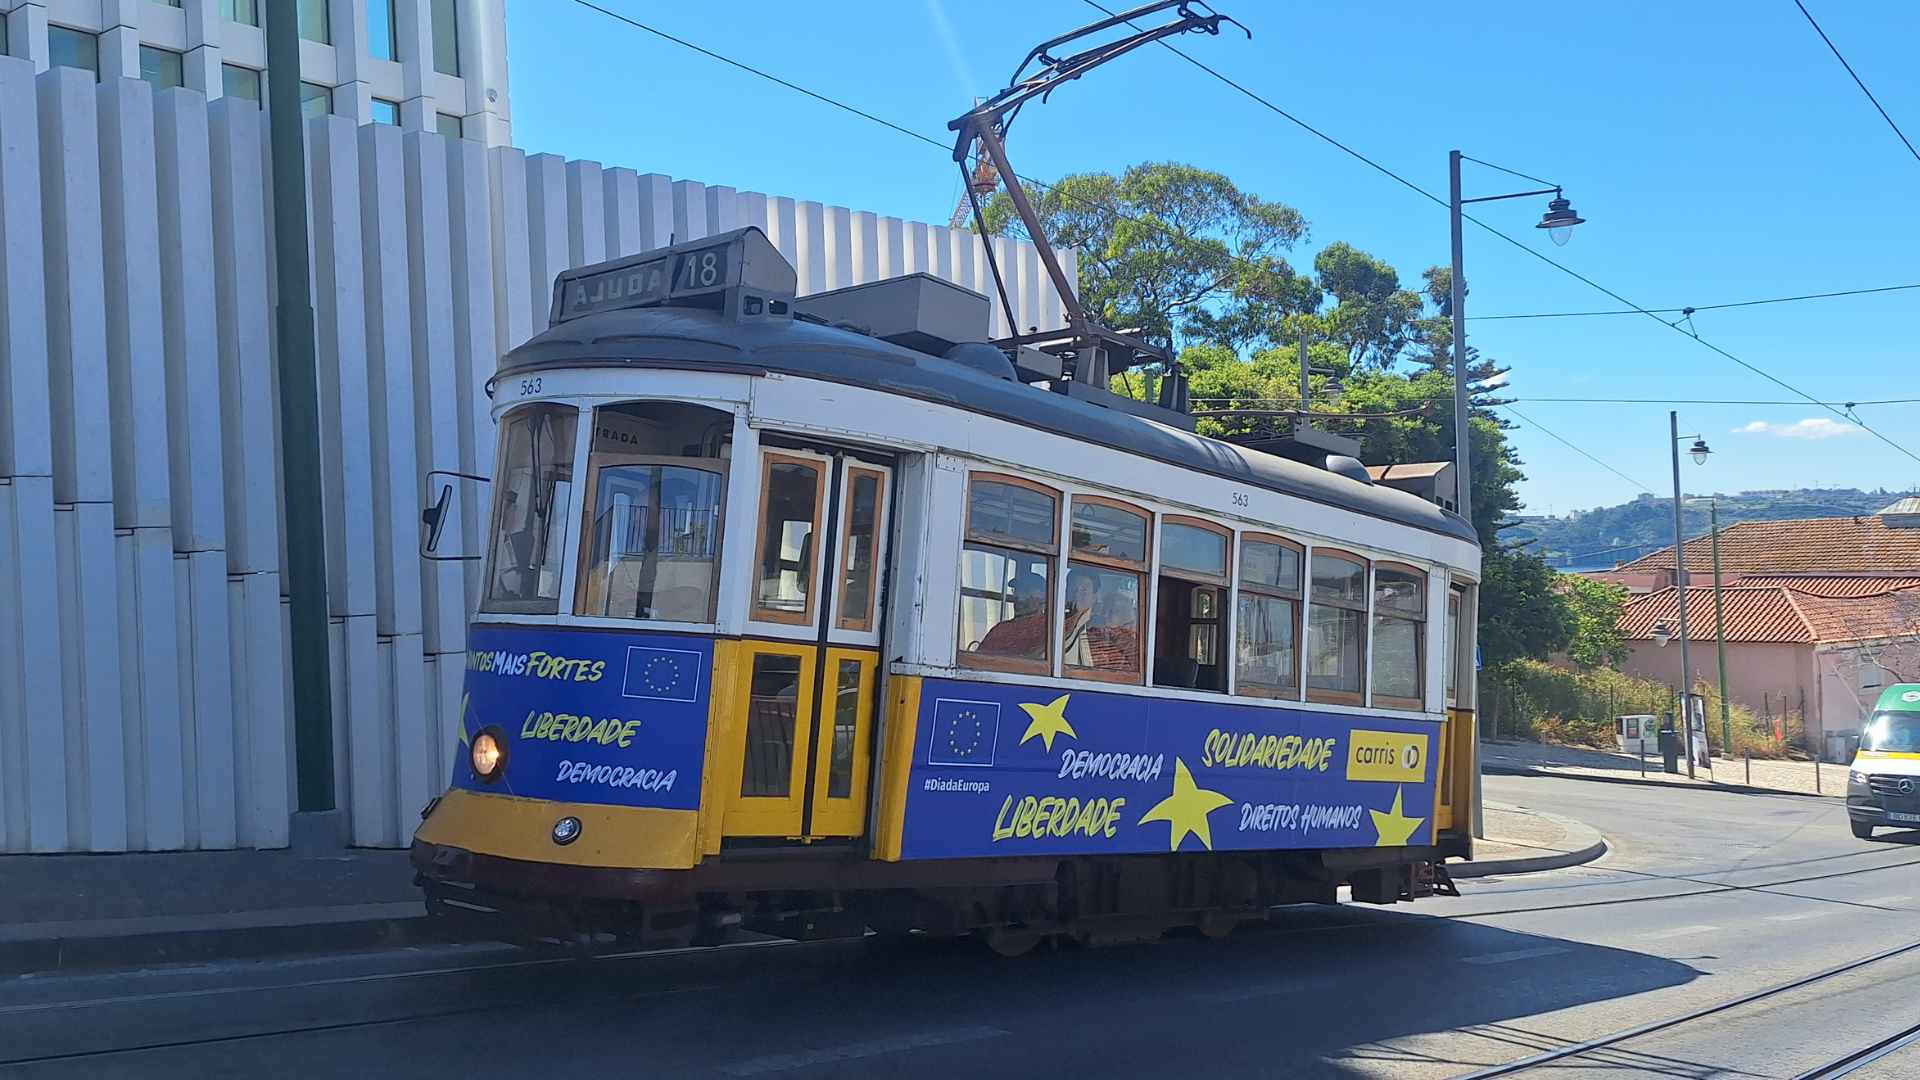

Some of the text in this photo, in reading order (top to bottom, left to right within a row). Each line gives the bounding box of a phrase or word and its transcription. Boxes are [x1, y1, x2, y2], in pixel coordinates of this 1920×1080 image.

[576, 252, 717, 304] AJUDA 18
[520, 377, 542, 396] 563
[1232, 492, 1249, 507] 563
[520, 710, 642, 748] LIBERDADE
[1058, 749, 1164, 783] DEMOCRACIA
[1201, 728, 1336, 772] SOLIDARIEDADE
[1355, 741, 1395, 765] carris
[556, 760, 678, 793] DEMOCRACIA
[924, 777, 990, 794] #DiadaEuropa
[992, 794, 1126, 842] LIBERDADE
[1238, 803, 1363, 837] DIREITOS HUMANOS
